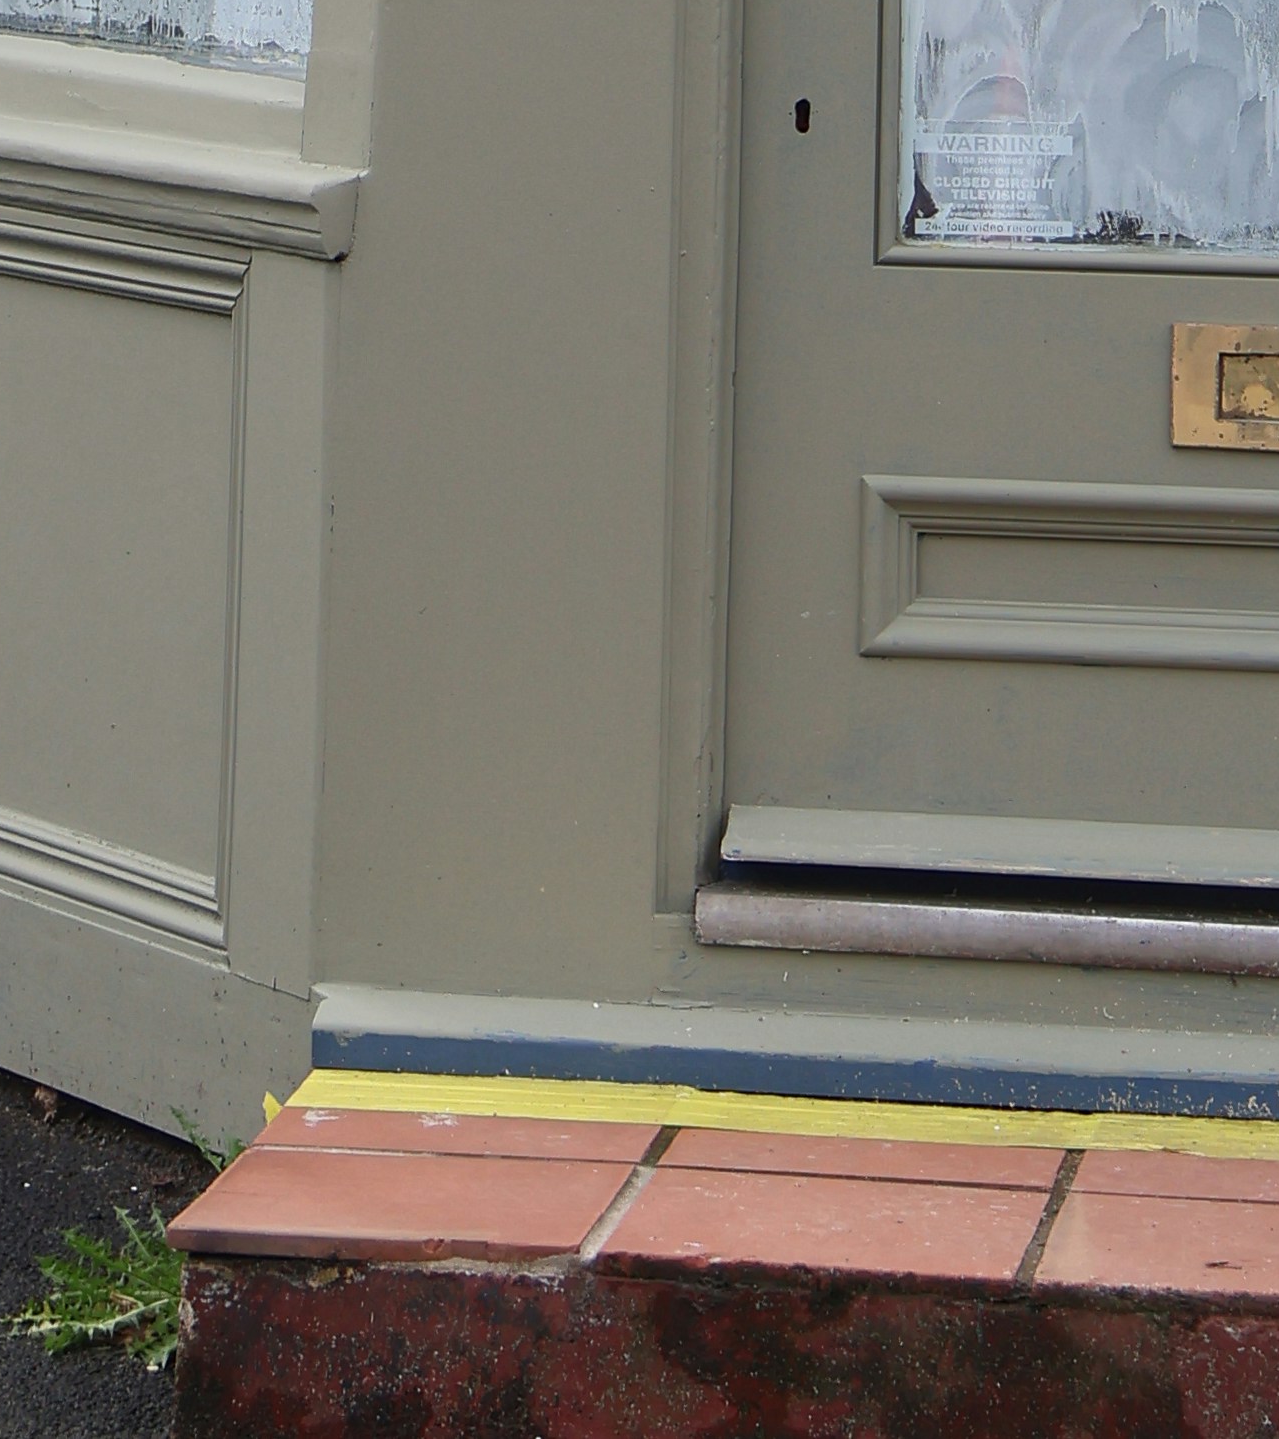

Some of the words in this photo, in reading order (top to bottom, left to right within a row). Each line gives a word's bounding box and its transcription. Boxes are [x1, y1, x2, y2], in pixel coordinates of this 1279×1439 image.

[937, 135, 1054, 153] WARNING
[933, 176, 991, 189] CLOSED
[994, 176, 1055, 190] CIRCUIT
[950, 189, 1038, 202] TELEVISION
[972, 222, 1004, 233] video
